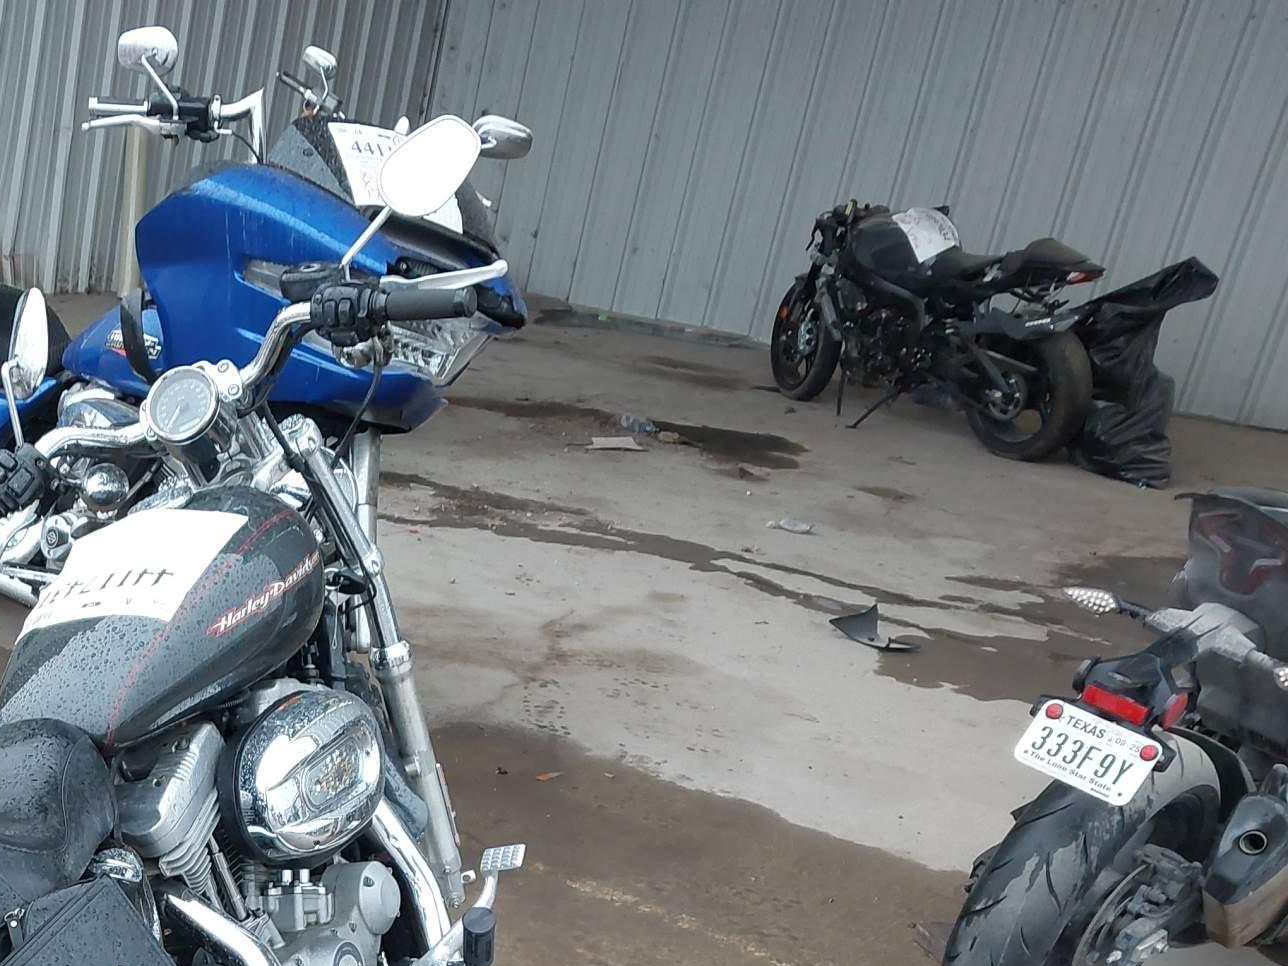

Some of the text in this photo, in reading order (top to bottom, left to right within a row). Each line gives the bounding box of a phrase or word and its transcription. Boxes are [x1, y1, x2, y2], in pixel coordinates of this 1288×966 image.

[1066, 715, 1107, 739] TEXAS
[1029, 751, 1112, 792] The Lone Star State
[1031, 726, 1134, 785] 333F9Y
